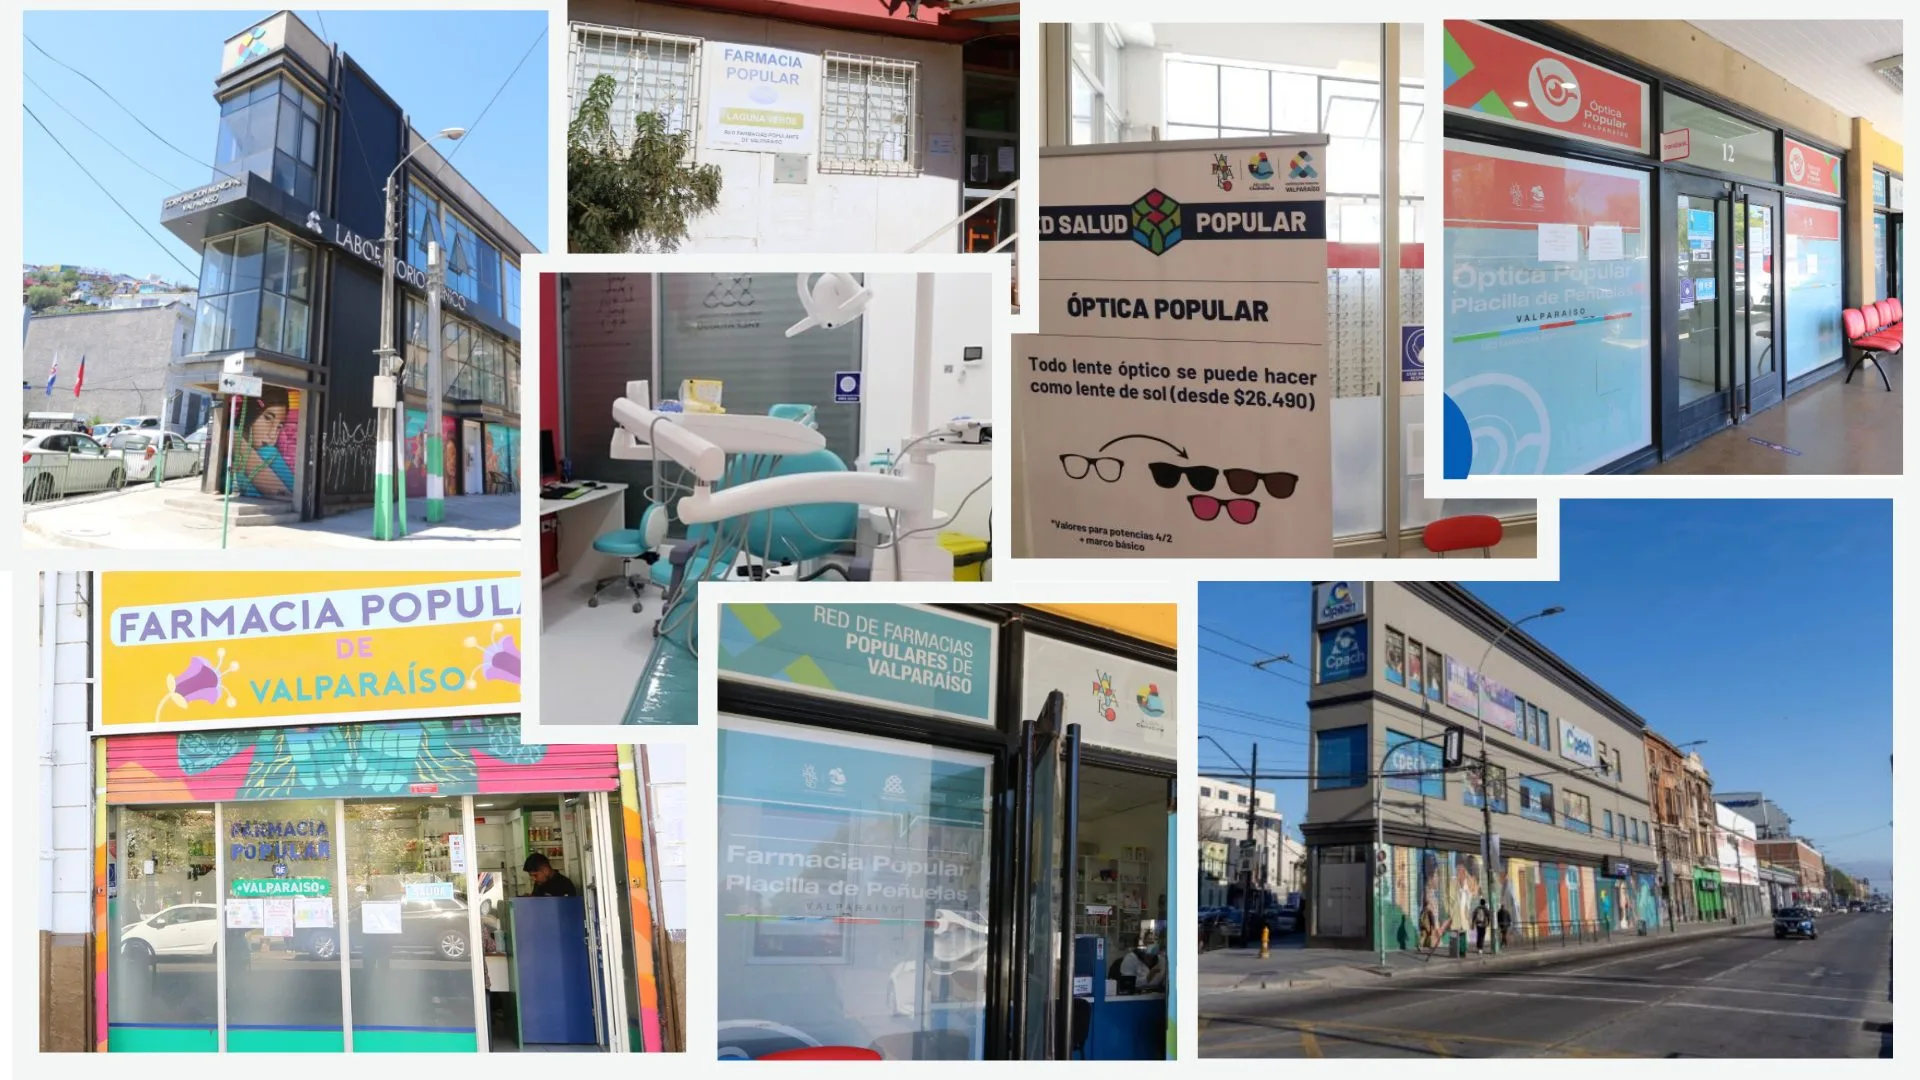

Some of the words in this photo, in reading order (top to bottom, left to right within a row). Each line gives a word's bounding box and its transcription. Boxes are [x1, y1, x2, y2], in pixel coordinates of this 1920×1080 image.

[724, 48, 803, 69] FARMACIA
[726, 66, 799, 86] POPULAR
[726, 112, 766, 123] LAGUNA
[1584, 109, 1627, 130] Popular
[1589, 99, 1622, 119] Óptica
[1722, 143, 1735, 163] 12
[1039, 215, 1054, 234] D
[1058, 214, 1128, 234] SALUD
[1196, 211, 1306, 234] POPULAR
[1452, 262, 1546, 292] Óptica
[1553, 261, 1632, 285] Popular
[1067, 292, 1149, 319] ÓPTICA
[1155, 298, 1268, 322] POPULAR
[1451, 291, 1529, 314] Placilla
[1535, 288, 1558, 306] de
[1028, 356, 1068, 374] Todo
[1072, 359, 1112, 376] lente
[1118, 360, 1170, 381] óptico
[1176, 366, 1197, 380] se
[1203, 366, 1258, 387] puede
[1264, 367, 1317, 387] hacer
[1030, 381, 1072, 395] como
[1076, 382, 1115, 398] lente
[1118, 384, 1140, 399] de
[1142, 386, 1167, 401] sol
[1170, 386, 1230, 406] (desde
[1234, 388, 1316, 412] $26.490)
[1086, 536, 1114, 548] marco
[1115, 537, 1145, 552] básico
[1088, 525, 1108, 538] para
[1110, 525, 1154, 543] potencias
[1155, 532, 1172, 544] 4/2
[120, 598, 344, 642] FARMACIA
[814, 604, 850, 629] RED
[855, 612, 880, 634] DE
[884, 618, 974, 658] FARMACIAS
[336, 636, 373, 660] DE
[846, 632, 948, 670] POPULARES
[952, 655, 973, 677] DE
[250, 661, 466, 704] VALPARAÍSO
[868, 656, 972, 695] VALPARAÍSO
[230, 819, 329, 838] FARMACIA
[230, 840, 331, 861] POPULAR
[727, 844, 864, 871] Farmacia
[872, 854, 970, 880] Popular
[275, 866, 286, 875] DE
[726, 874, 820, 896] Placilla
[828, 879, 860, 897] de
[866, 880, 969, 902] Peñuelas
